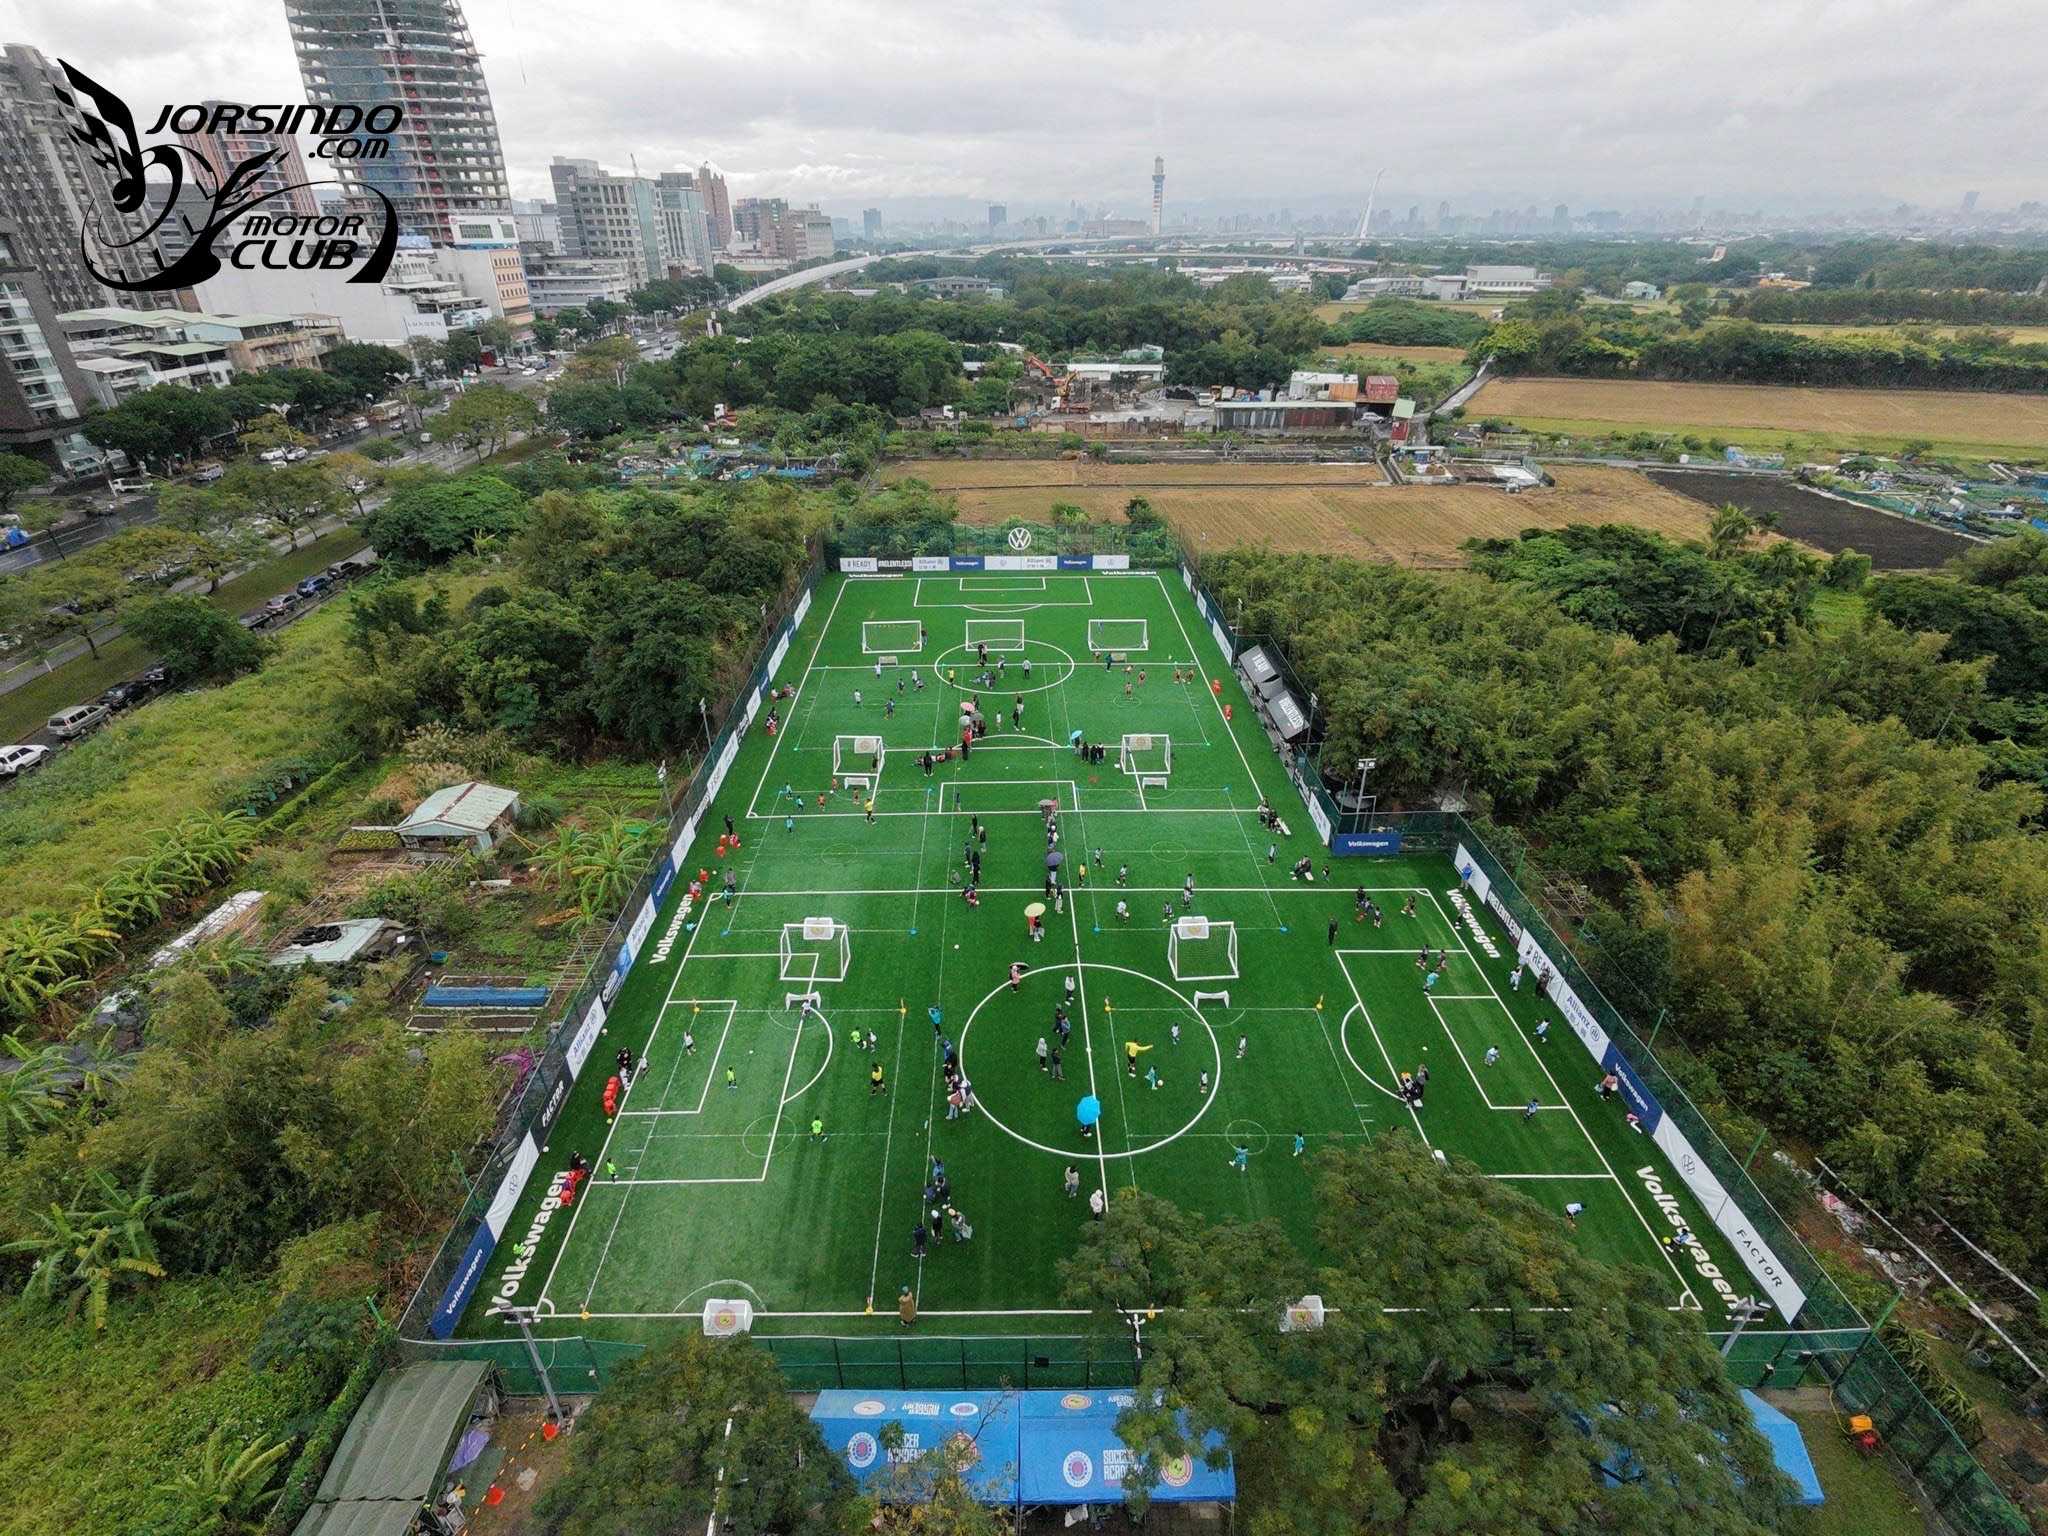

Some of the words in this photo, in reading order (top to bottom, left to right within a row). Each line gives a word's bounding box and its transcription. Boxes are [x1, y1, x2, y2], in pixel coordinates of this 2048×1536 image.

[649, 894, 694, 964] Volkswagen
[1566, 995, 1591, 1029] Allianz
[1615, 1062, 1649, 1112] Volkswagen
[446, 1249, 483, 1314] Volkswagen
[1736, 1229, 1783, 1287] FACTOR
